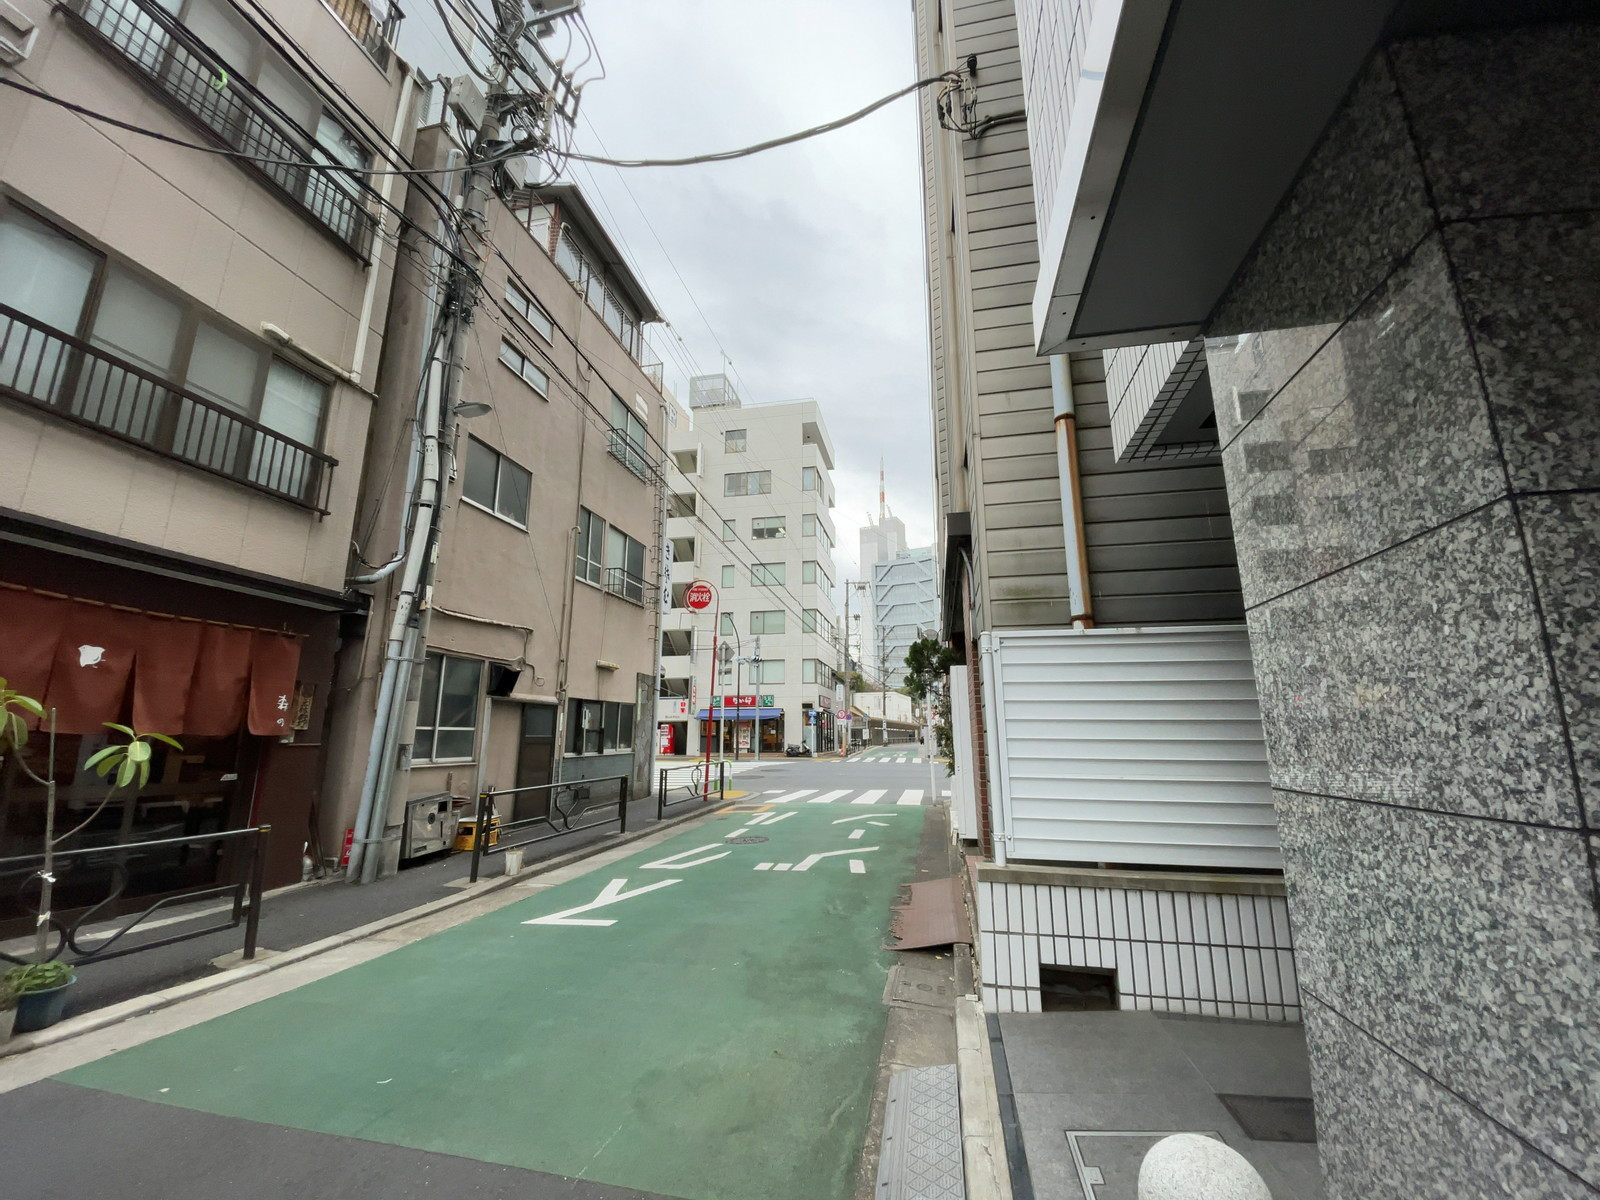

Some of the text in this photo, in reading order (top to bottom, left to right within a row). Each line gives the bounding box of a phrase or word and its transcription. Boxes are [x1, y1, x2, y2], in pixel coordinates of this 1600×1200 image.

[689, 592, 711, 603] 消火栓
[520, 811, 798, 926] スクール
[752, 813, 898, 874] ゾーン
